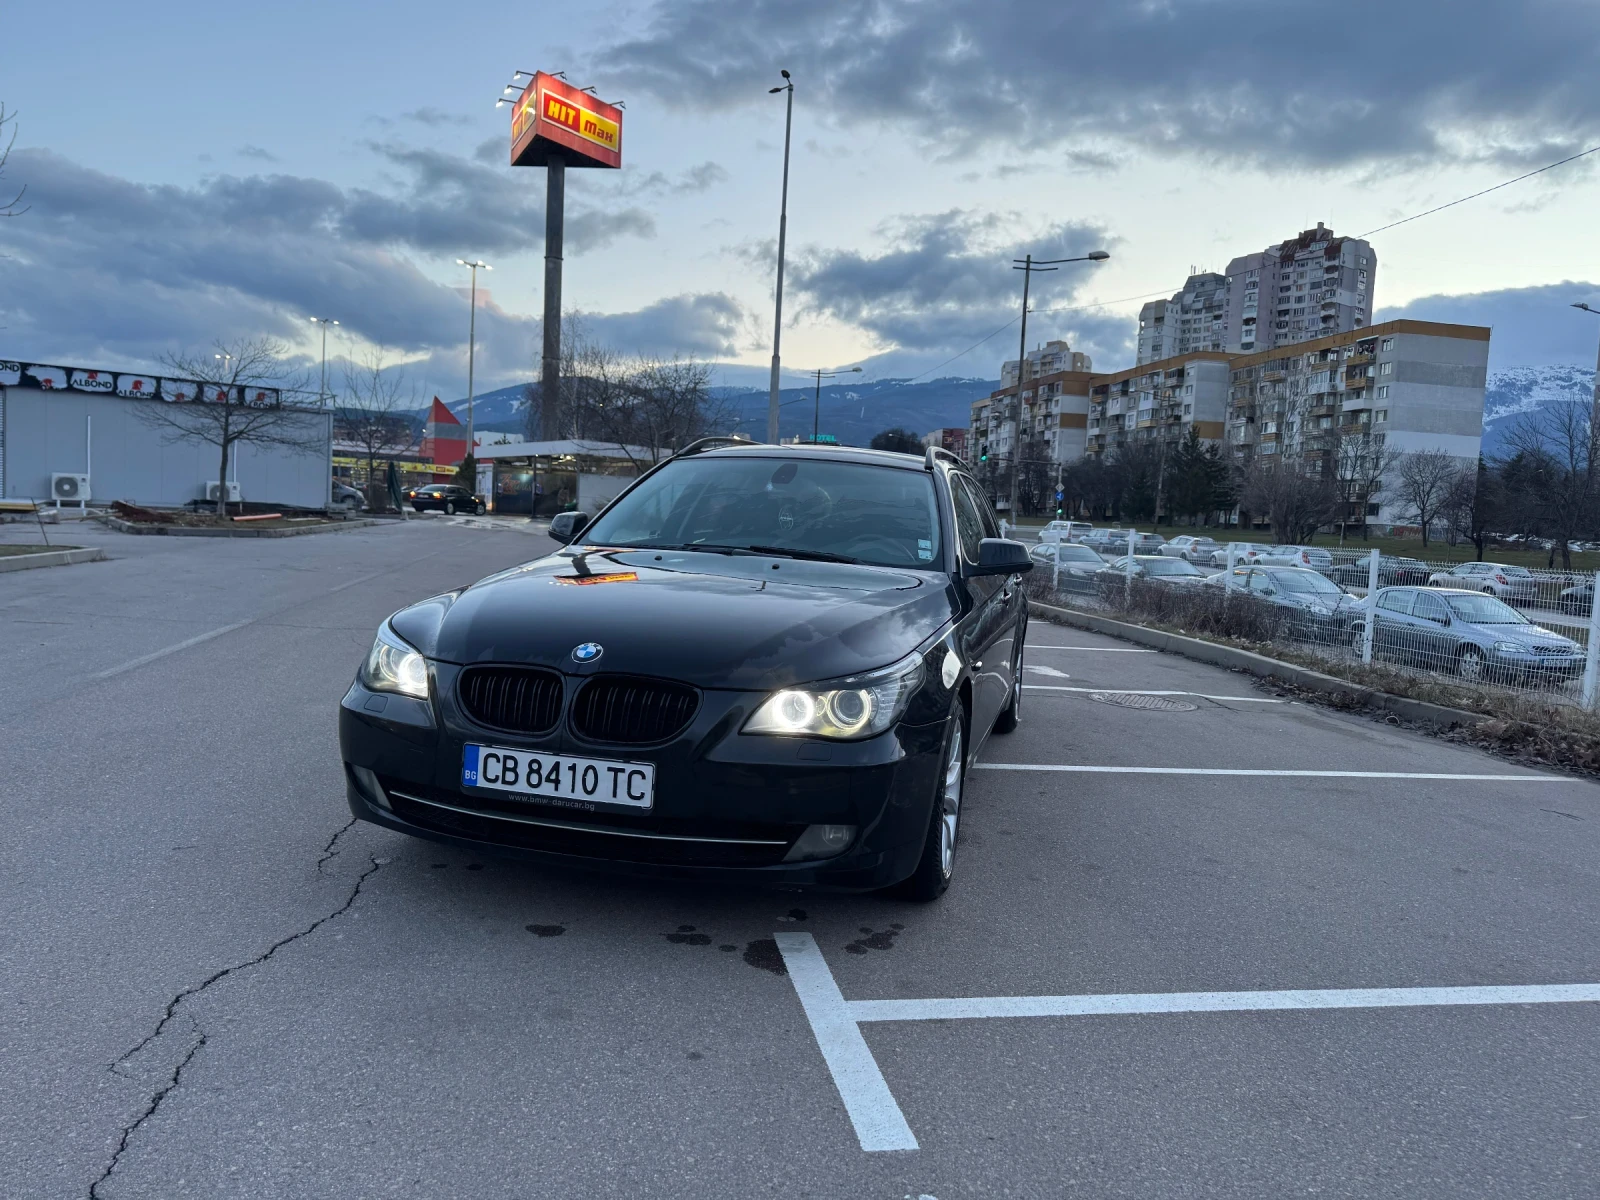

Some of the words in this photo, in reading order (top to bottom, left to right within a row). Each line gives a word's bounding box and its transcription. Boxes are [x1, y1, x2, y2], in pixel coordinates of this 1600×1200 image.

[548, 100, 575, 125] HIT
[72, 379, 112, 389] ALBOND
[809, 434, 836, 442] HOTEL
[465, 769, 477, 780] BG
[482, 752, 519, 786] CB
[526, 759, 598, 795] 8410
[607, 766, 646, 801] TC
